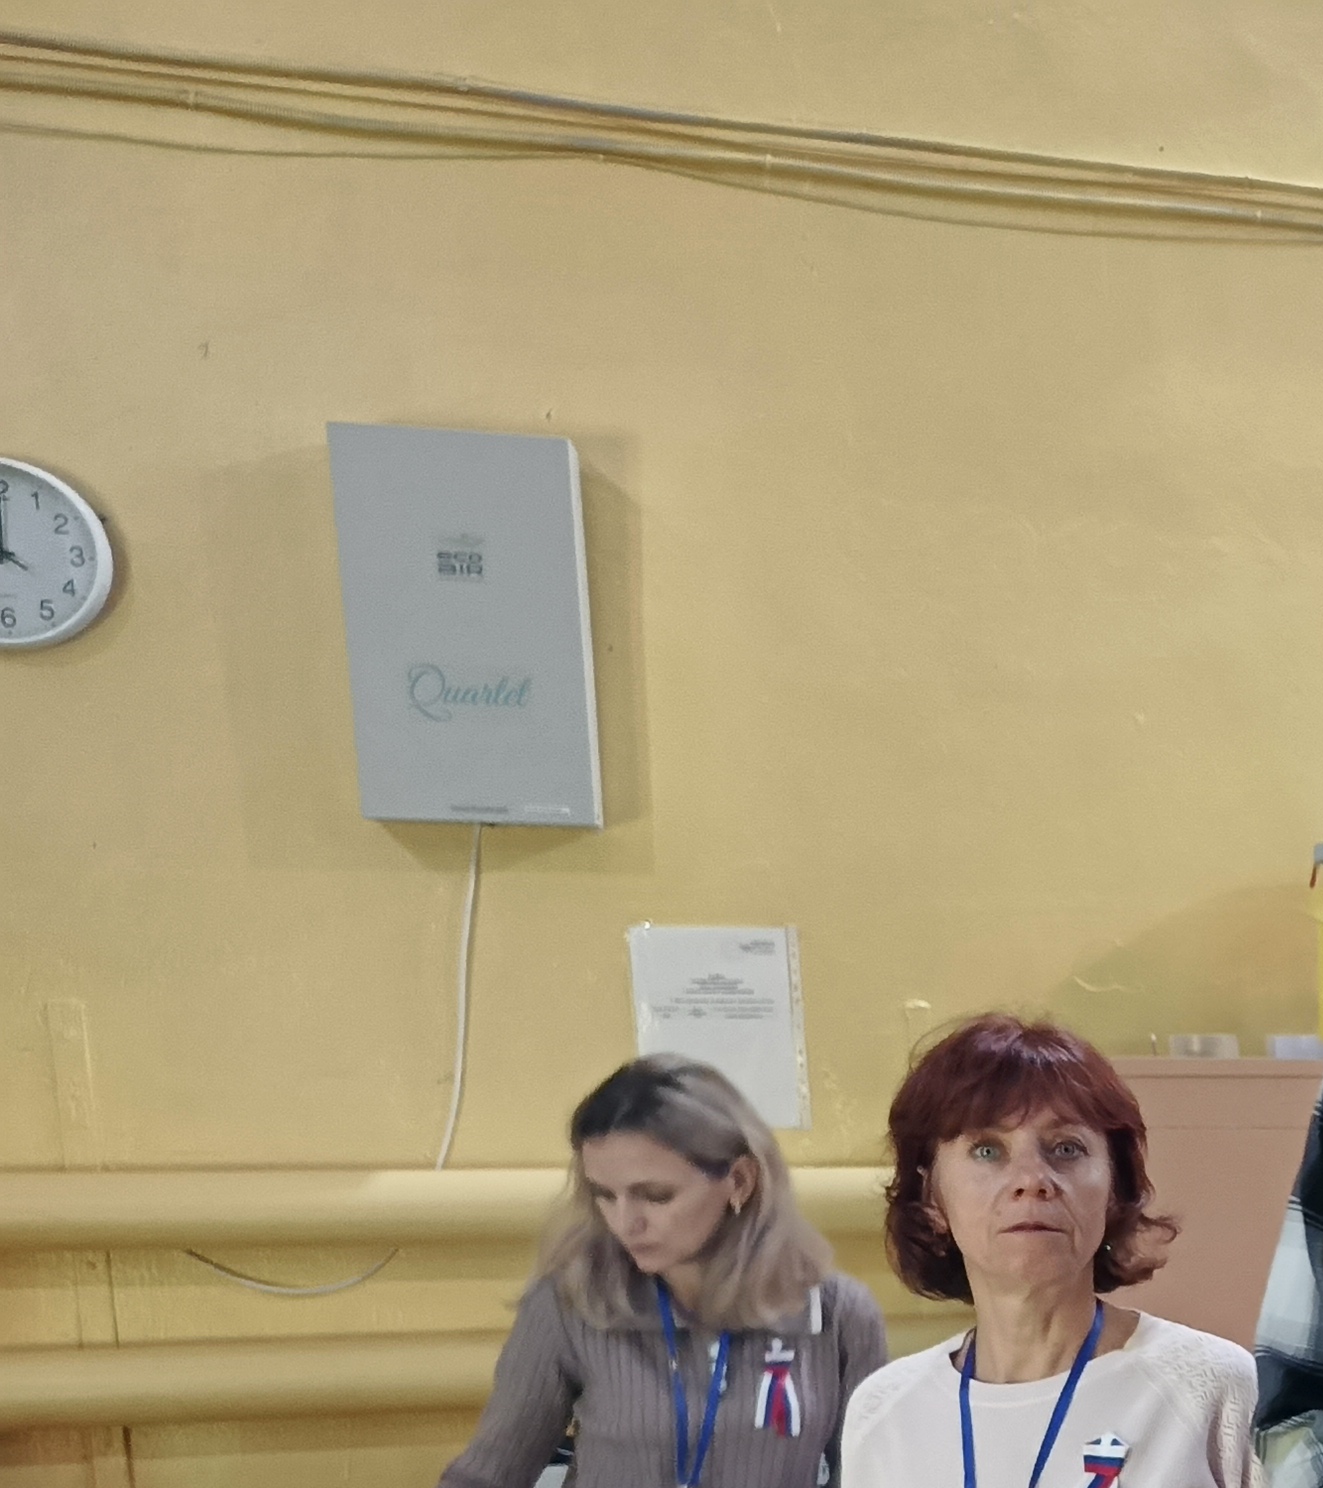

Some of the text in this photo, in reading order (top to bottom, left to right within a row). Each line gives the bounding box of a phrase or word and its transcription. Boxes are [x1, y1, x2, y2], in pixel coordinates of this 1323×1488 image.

[30, 491, 41, 511] 1
[53, 513, 69, 535] 2
[69, 545, 86, 569] 3
[62, 579, 77, 597] 4
[0, 607, 17, 628] 6
[39, 599, 55, 621] 5
